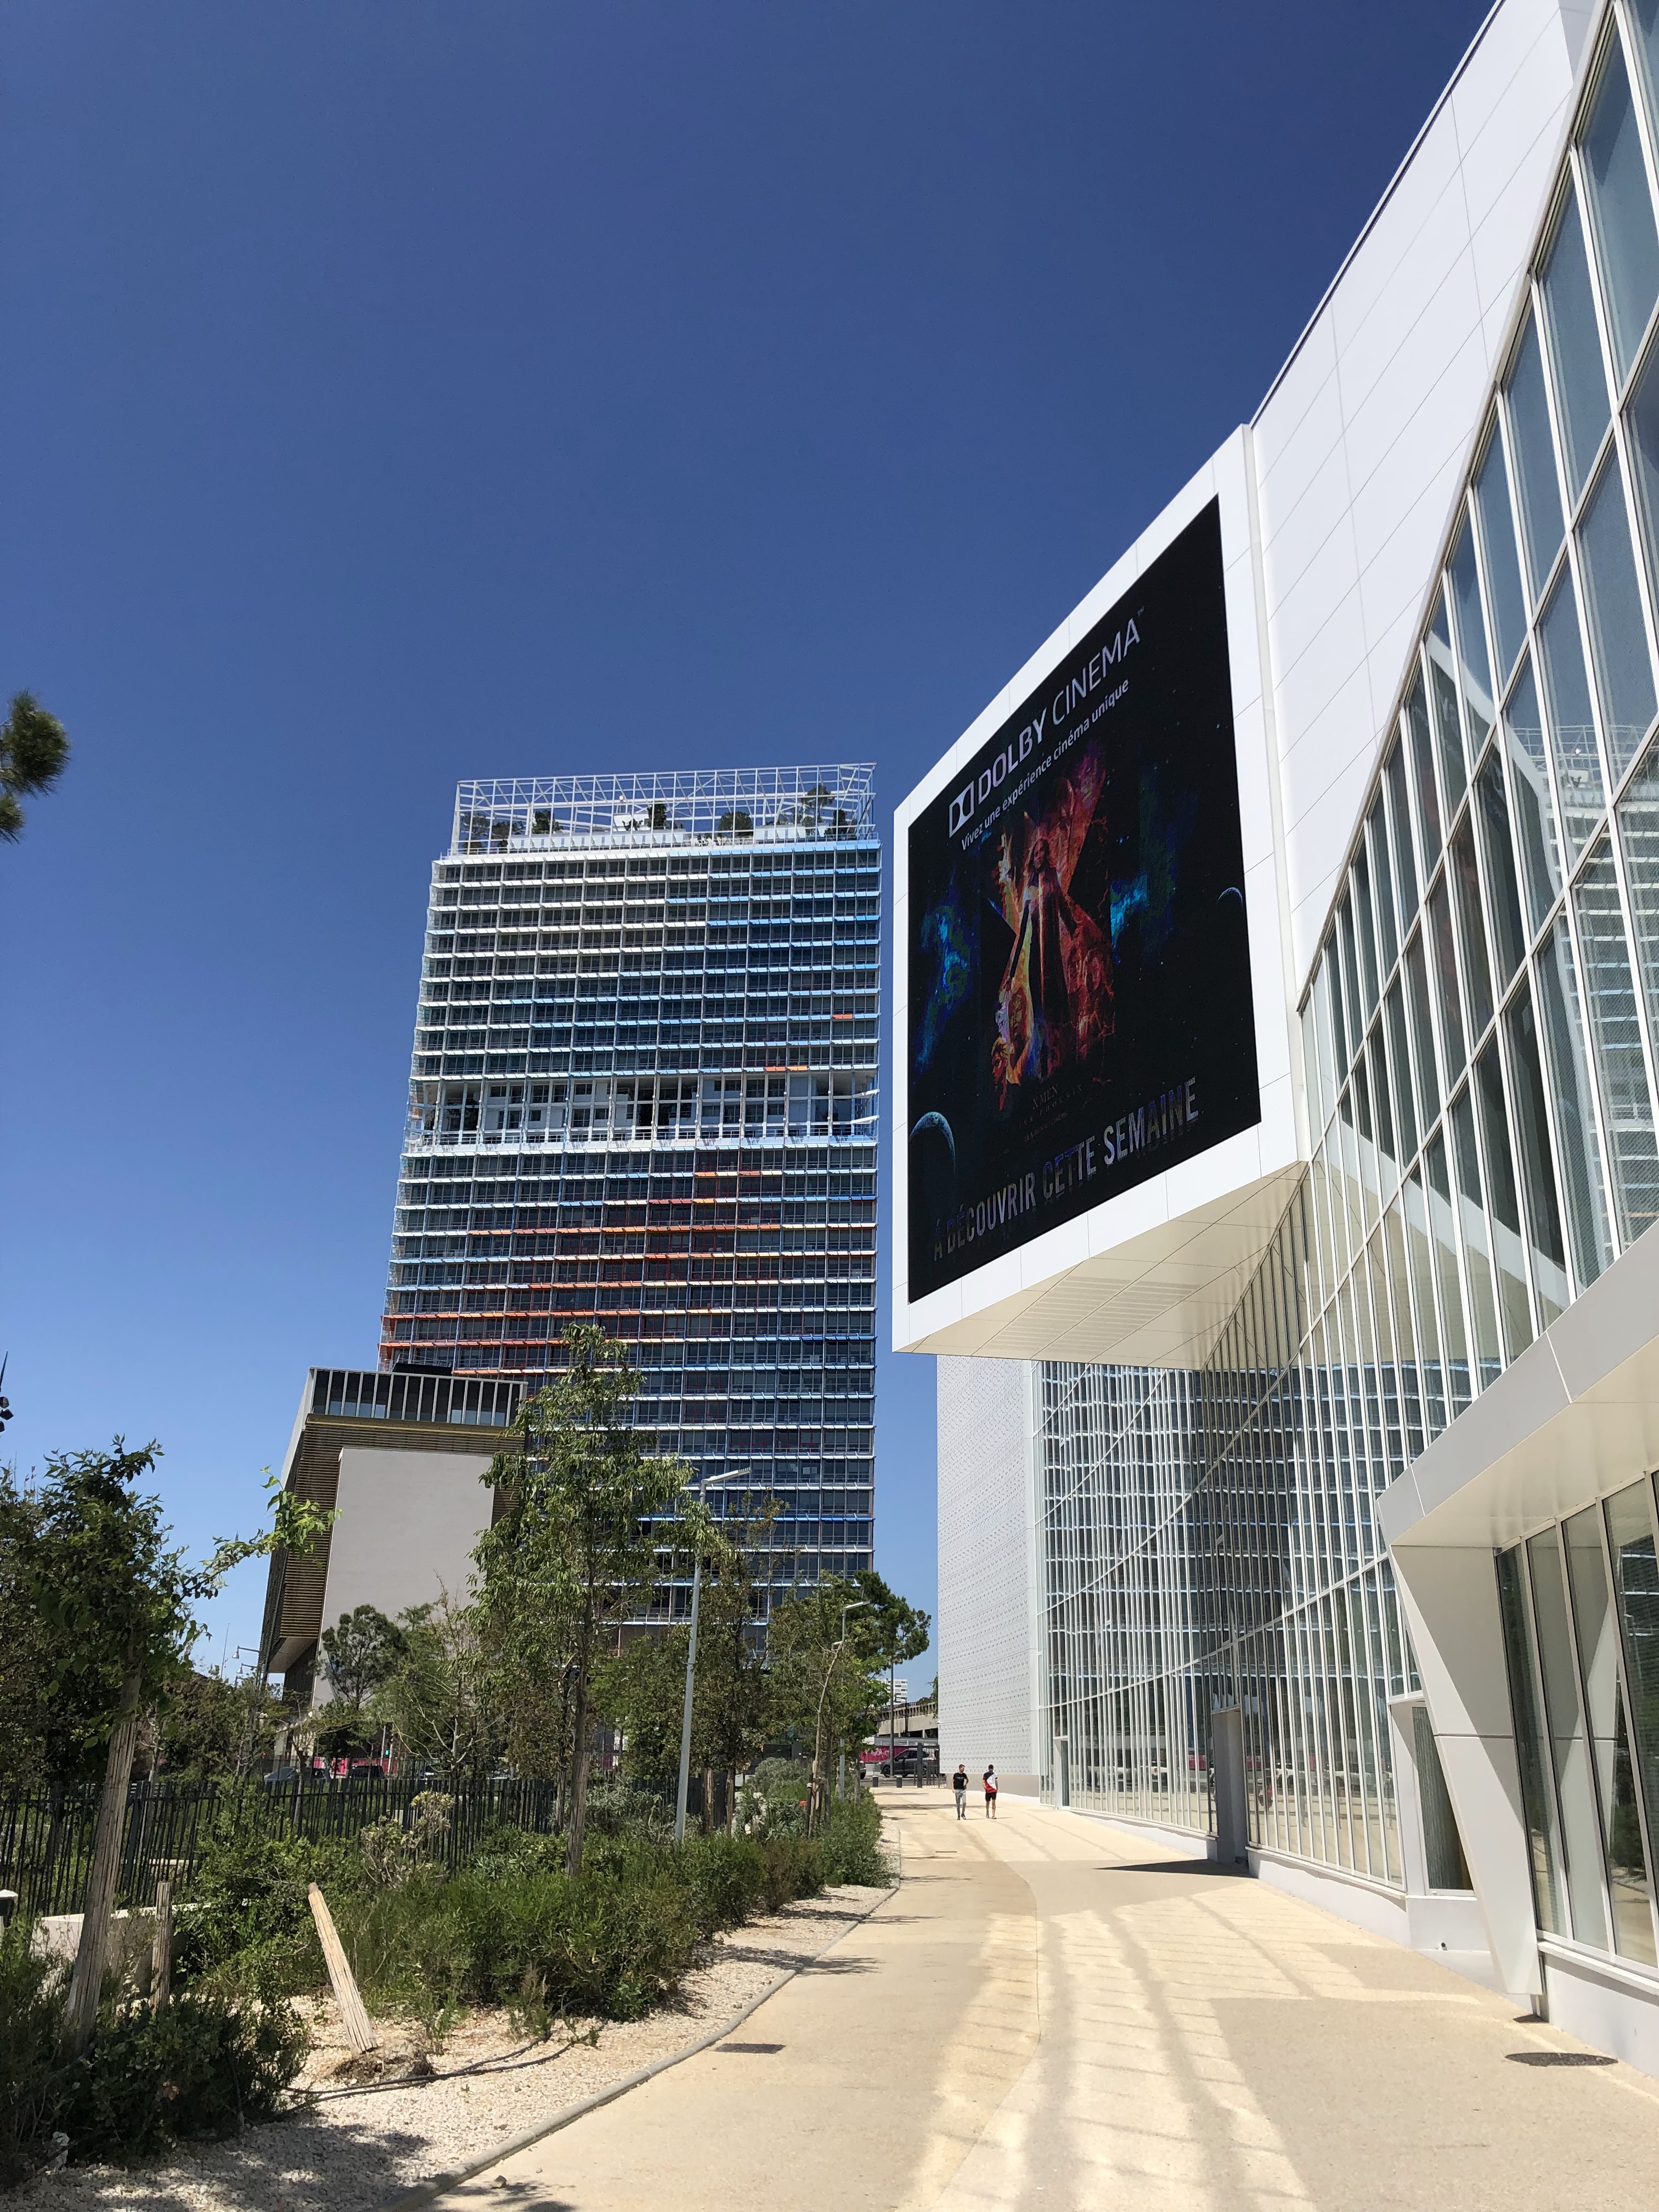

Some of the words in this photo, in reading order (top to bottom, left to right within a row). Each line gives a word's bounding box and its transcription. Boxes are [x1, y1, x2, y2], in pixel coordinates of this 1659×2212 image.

[961, 823, 984, 851] Vivez
[984, 805, 1001, 829] une
[1002, 755, 1052, 811] expérience
[1053, 718, 1090, 760] cinéma
[1091, 679, 1129, 724] unique
[978, 707, 1047, 805] DOLBY
[1052, 618, 1141, 726] CINEMA
[946, 1172, 1036, 1255] DÉCOUVRIR
[1042, 1135, 1097, 1200] CETTE
[1103, 1076, 1199, 1166] SEMAINE
